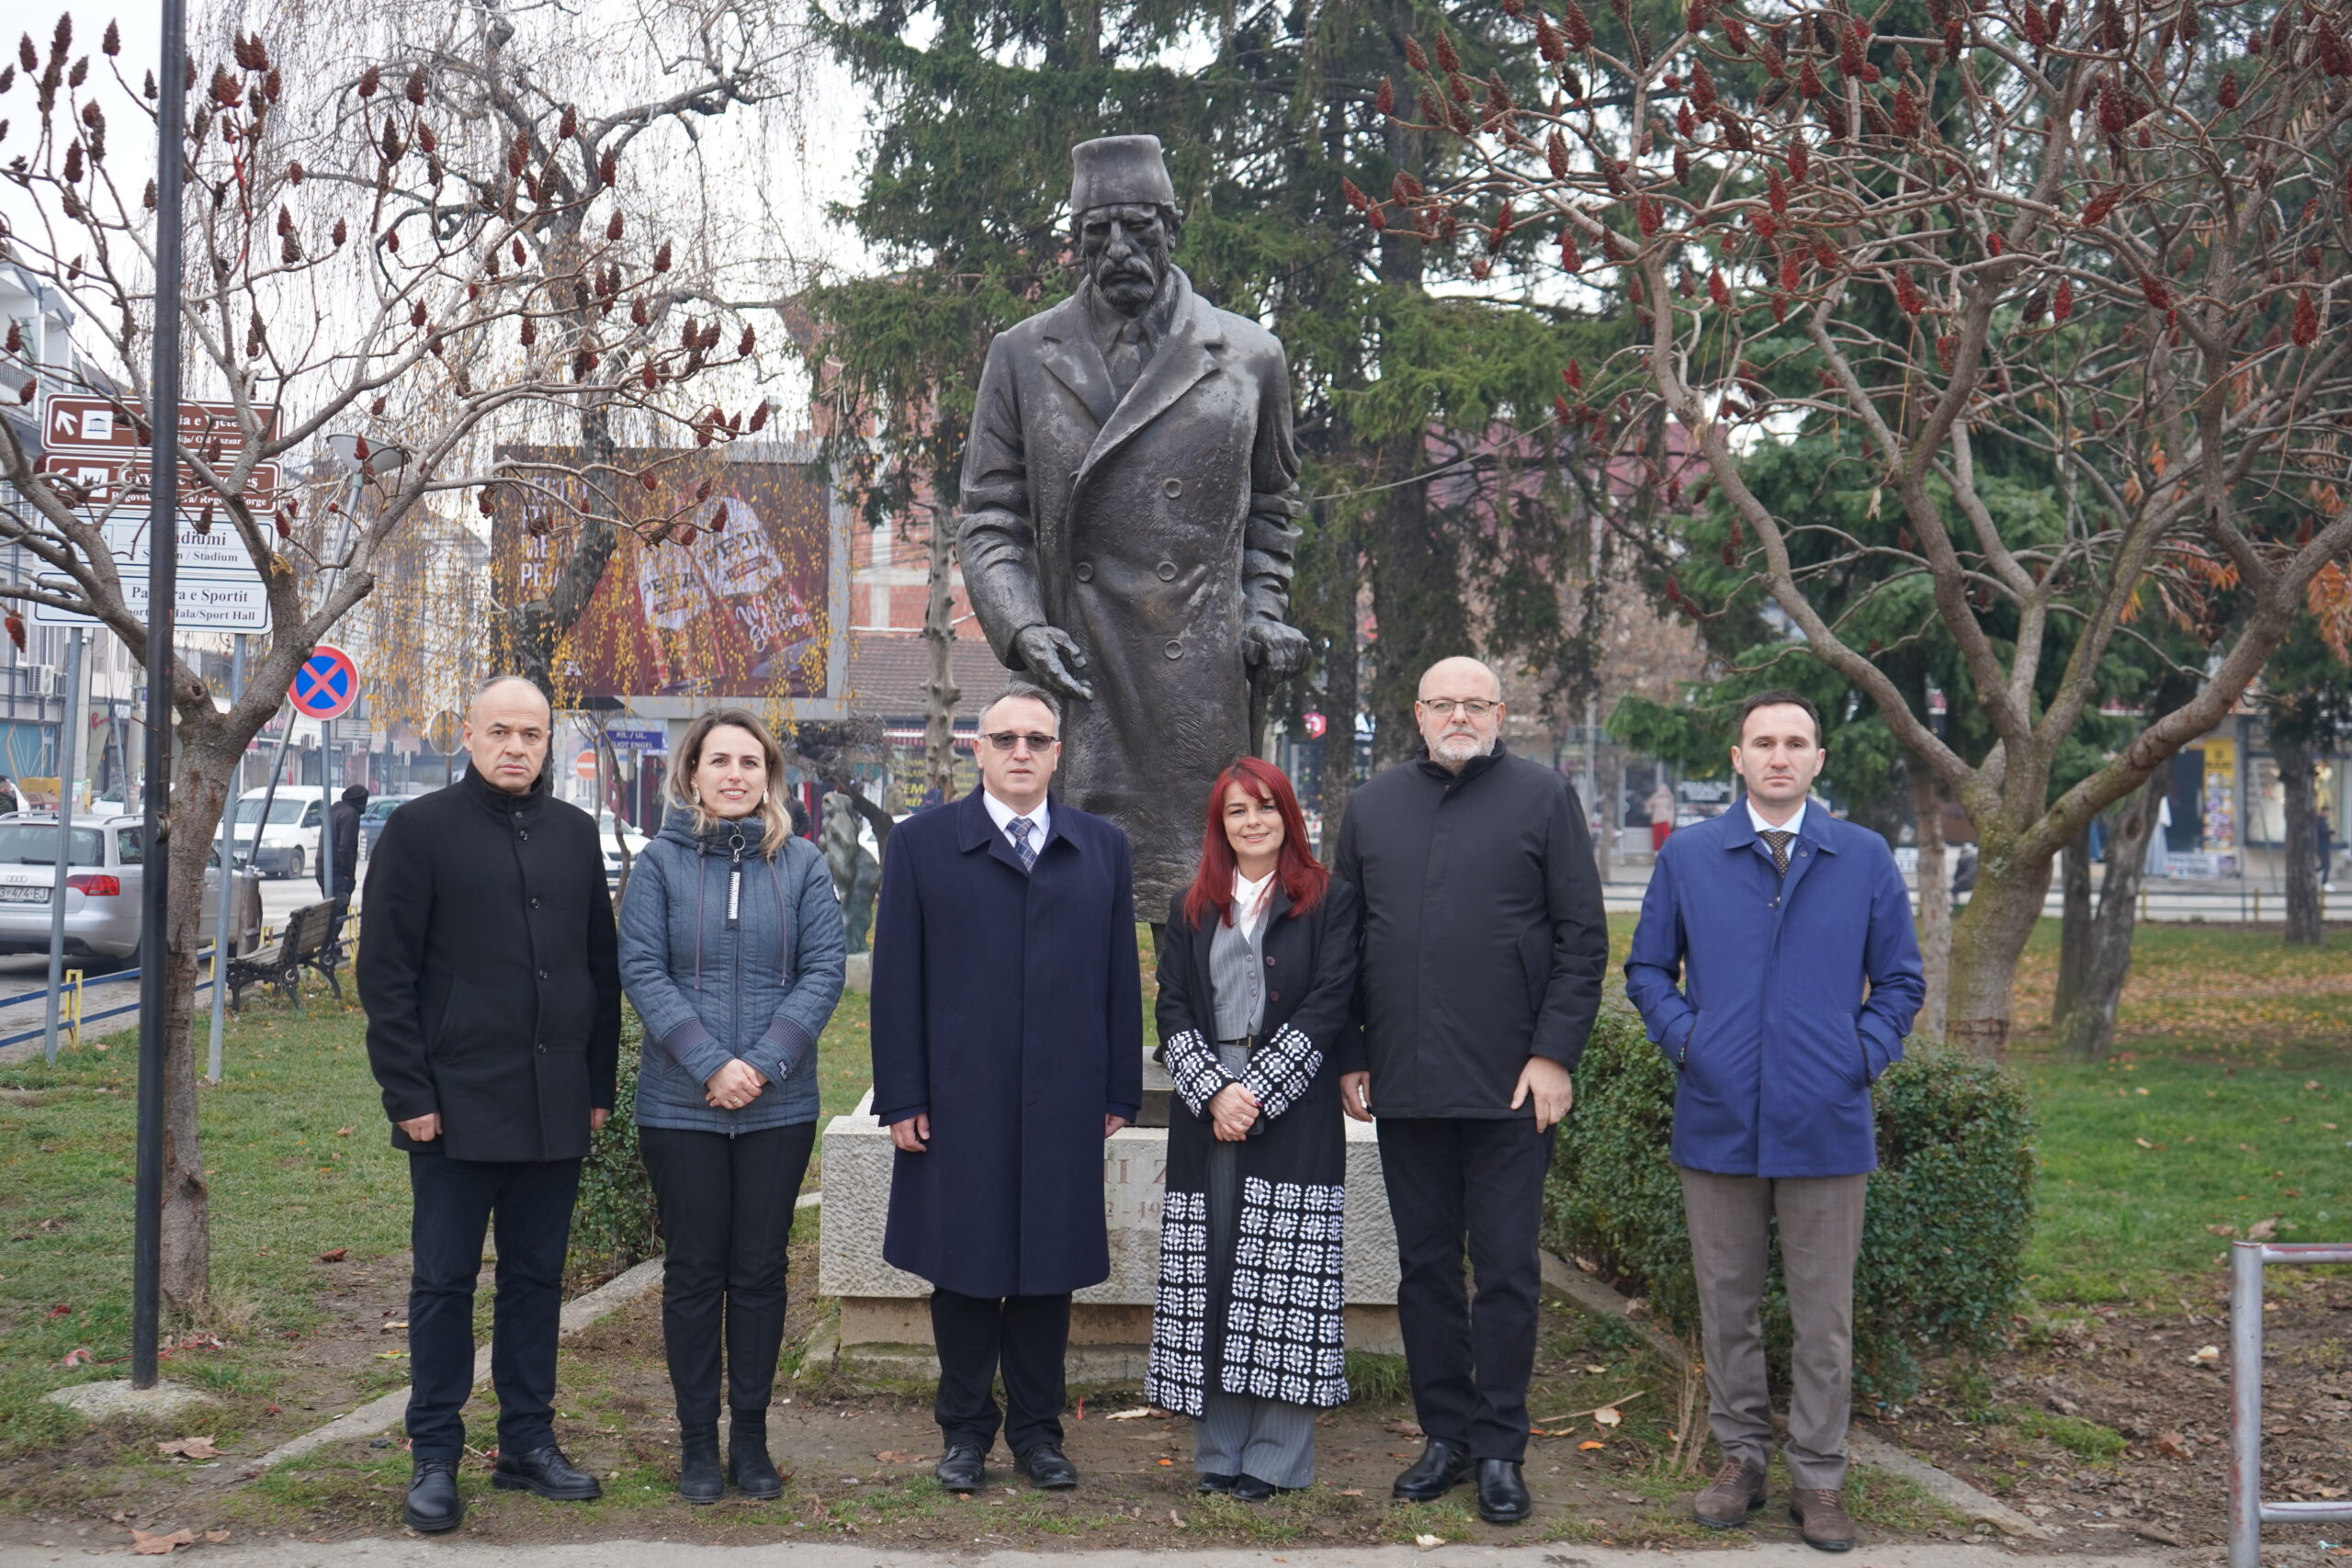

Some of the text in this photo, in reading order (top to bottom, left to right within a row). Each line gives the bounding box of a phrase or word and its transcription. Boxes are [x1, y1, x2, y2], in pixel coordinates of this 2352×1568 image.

[243, 497, 266, 507] orge
[193, 551, 238, 562] Stadium
[190, 592, 198, 600] e
[201, 589, 248, 604] Sportit
[232, 611, 255, 621] Hall
[630, 741, 654, 750] ENGEL
